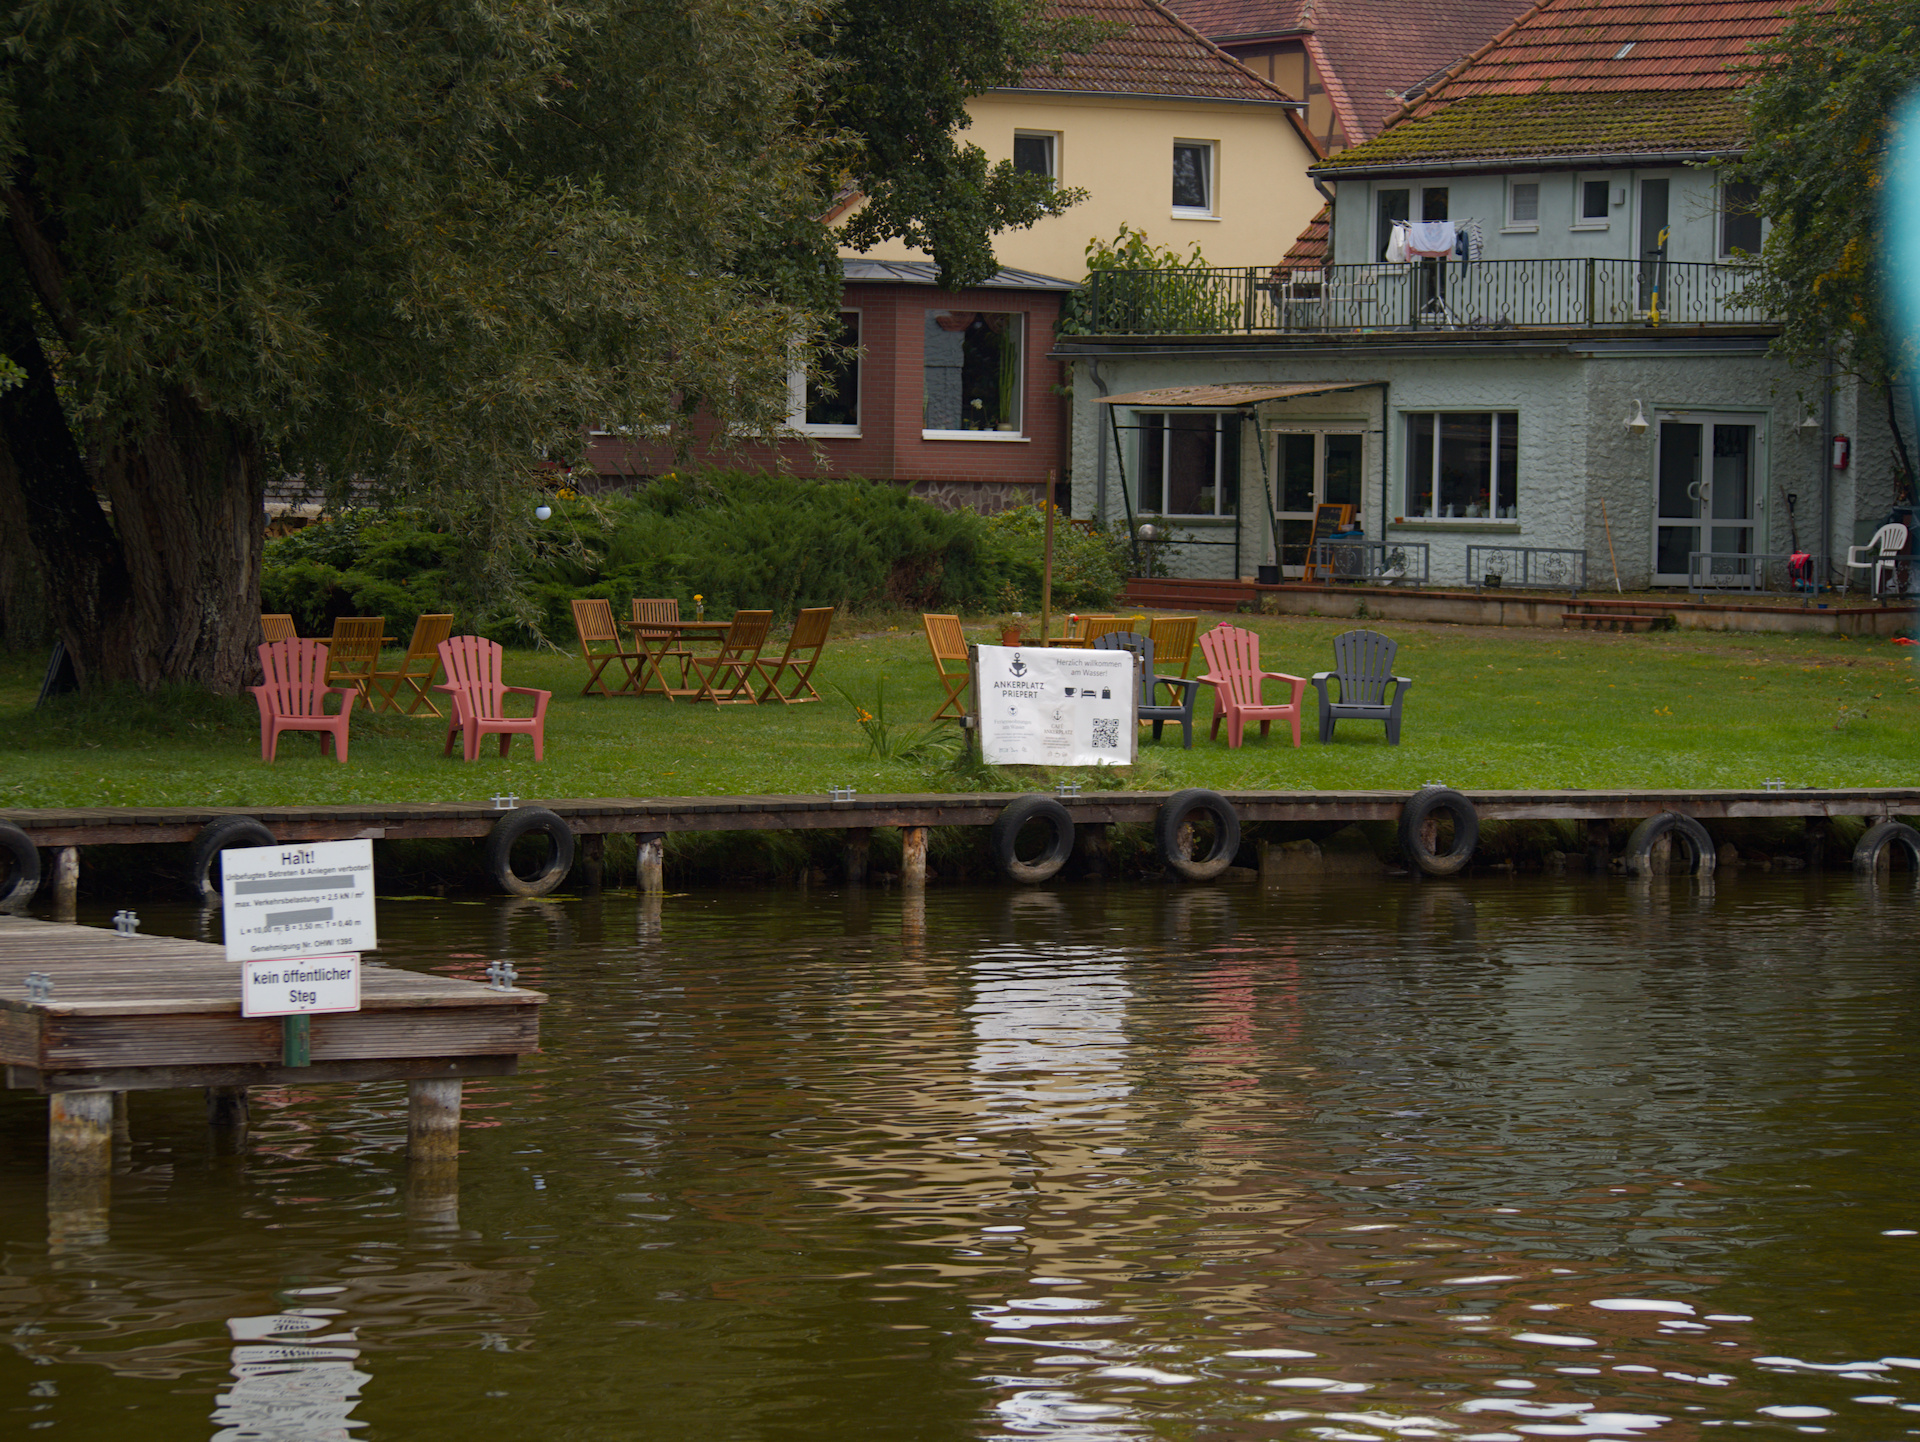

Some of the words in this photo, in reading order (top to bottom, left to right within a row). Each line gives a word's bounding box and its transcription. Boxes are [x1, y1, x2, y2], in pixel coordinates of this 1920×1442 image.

[1084, 660, 1122, 668] willkommen
[994, 681, 1044, 690] ANKERPLATZ
[1002, 690, 1038, 698] PRIEPERT
[281, 850, 315, 866] Halt!
[226, 872, 266, 882] Unbefugtes
[268, 869, 298, 878] Betreten
[307, 867, 337, 876] Anliegen
[338, 864, 371, 872] verboten!
[253, 896, 320, 906] Verkehrsbelastung
[251, 943, 300, 952] Genehmigung
[253, 972, 279, 984] kein
[282, 968, 352, 983] öffentlicher
[289, 990, 316, 1004] Steg
